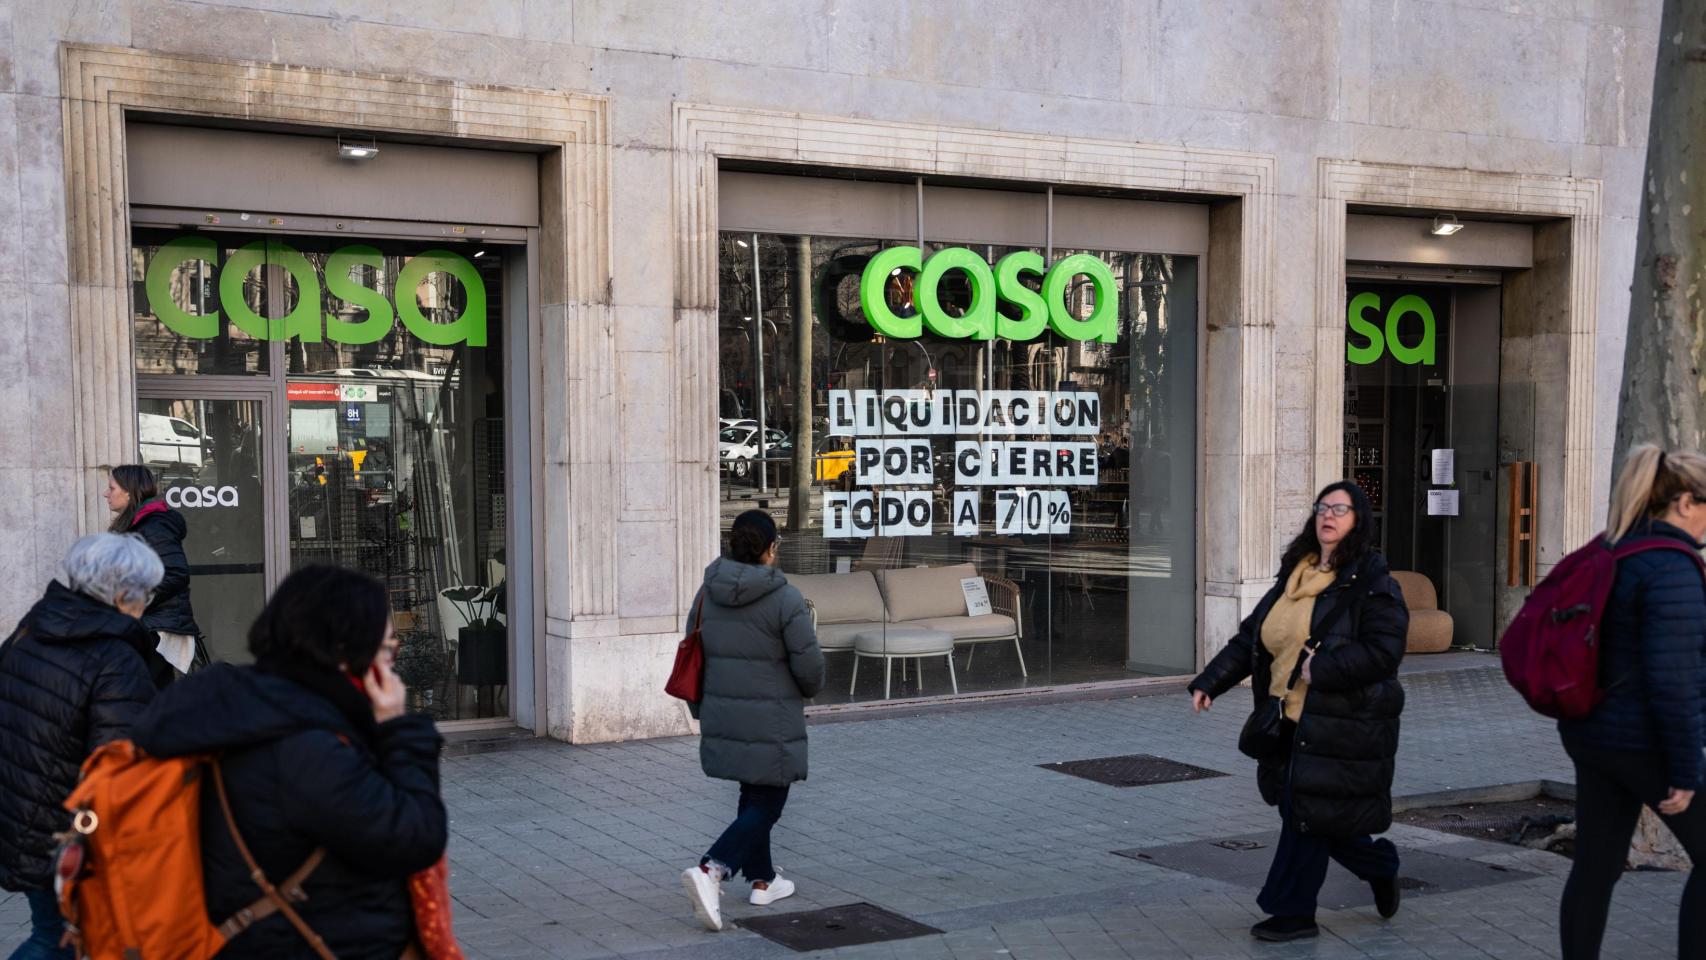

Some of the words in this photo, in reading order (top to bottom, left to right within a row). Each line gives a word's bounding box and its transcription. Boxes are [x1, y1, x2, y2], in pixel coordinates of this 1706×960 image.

[145, 236, 487, 347] casa
[860, 246, 1119, 344] casa
[837, 395, 1099, 431] LIQUIDACION
[860, 445, 932, 477] POR
[957, 447, 1096, 477] CIERRE
[165, 485, 239, 508] casa
[828, 496, 931, 530] TODO
[957, 499, 977, 527] A
[1000, 491, 1070, 530] 70%
